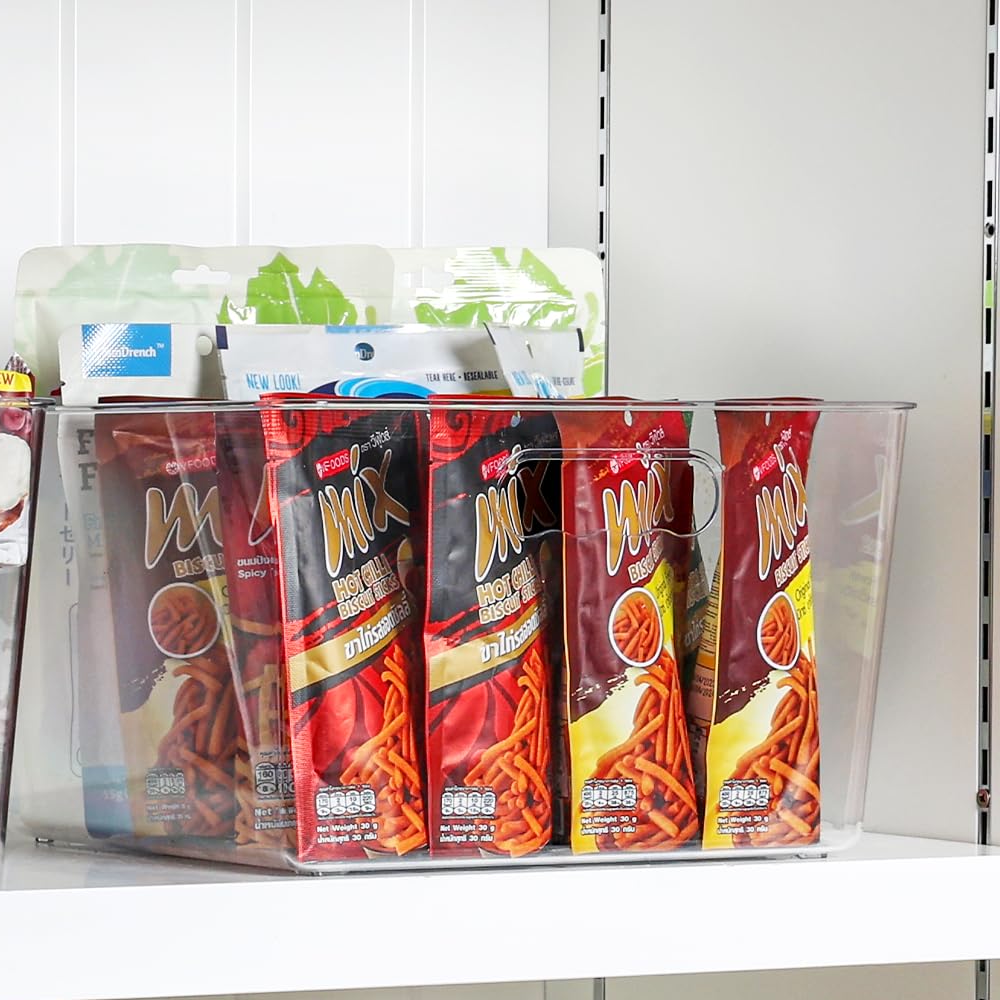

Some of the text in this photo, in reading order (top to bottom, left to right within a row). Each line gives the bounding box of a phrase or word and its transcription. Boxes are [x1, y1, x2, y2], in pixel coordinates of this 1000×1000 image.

[246, 372, 301, 391] NEW LOOK!
[426, 370, 499, 382] TEAR HERE RESEALABLE
[237, 569, 267, 579] Spicy
[332, 569, 363, 602] HOT
[476, 573, 511, 607] HOT
[337, 588, 376, 620] BISCUIT
[479, 591, 521, 624] BISCUIT
[255, 808, 272, 817] Net
[594, 816, 617, 824] Weight
[730, 816, 752, 824] Weight
[317, 825, 329, 833] Net
[332, 823, 358, 833] Weight
